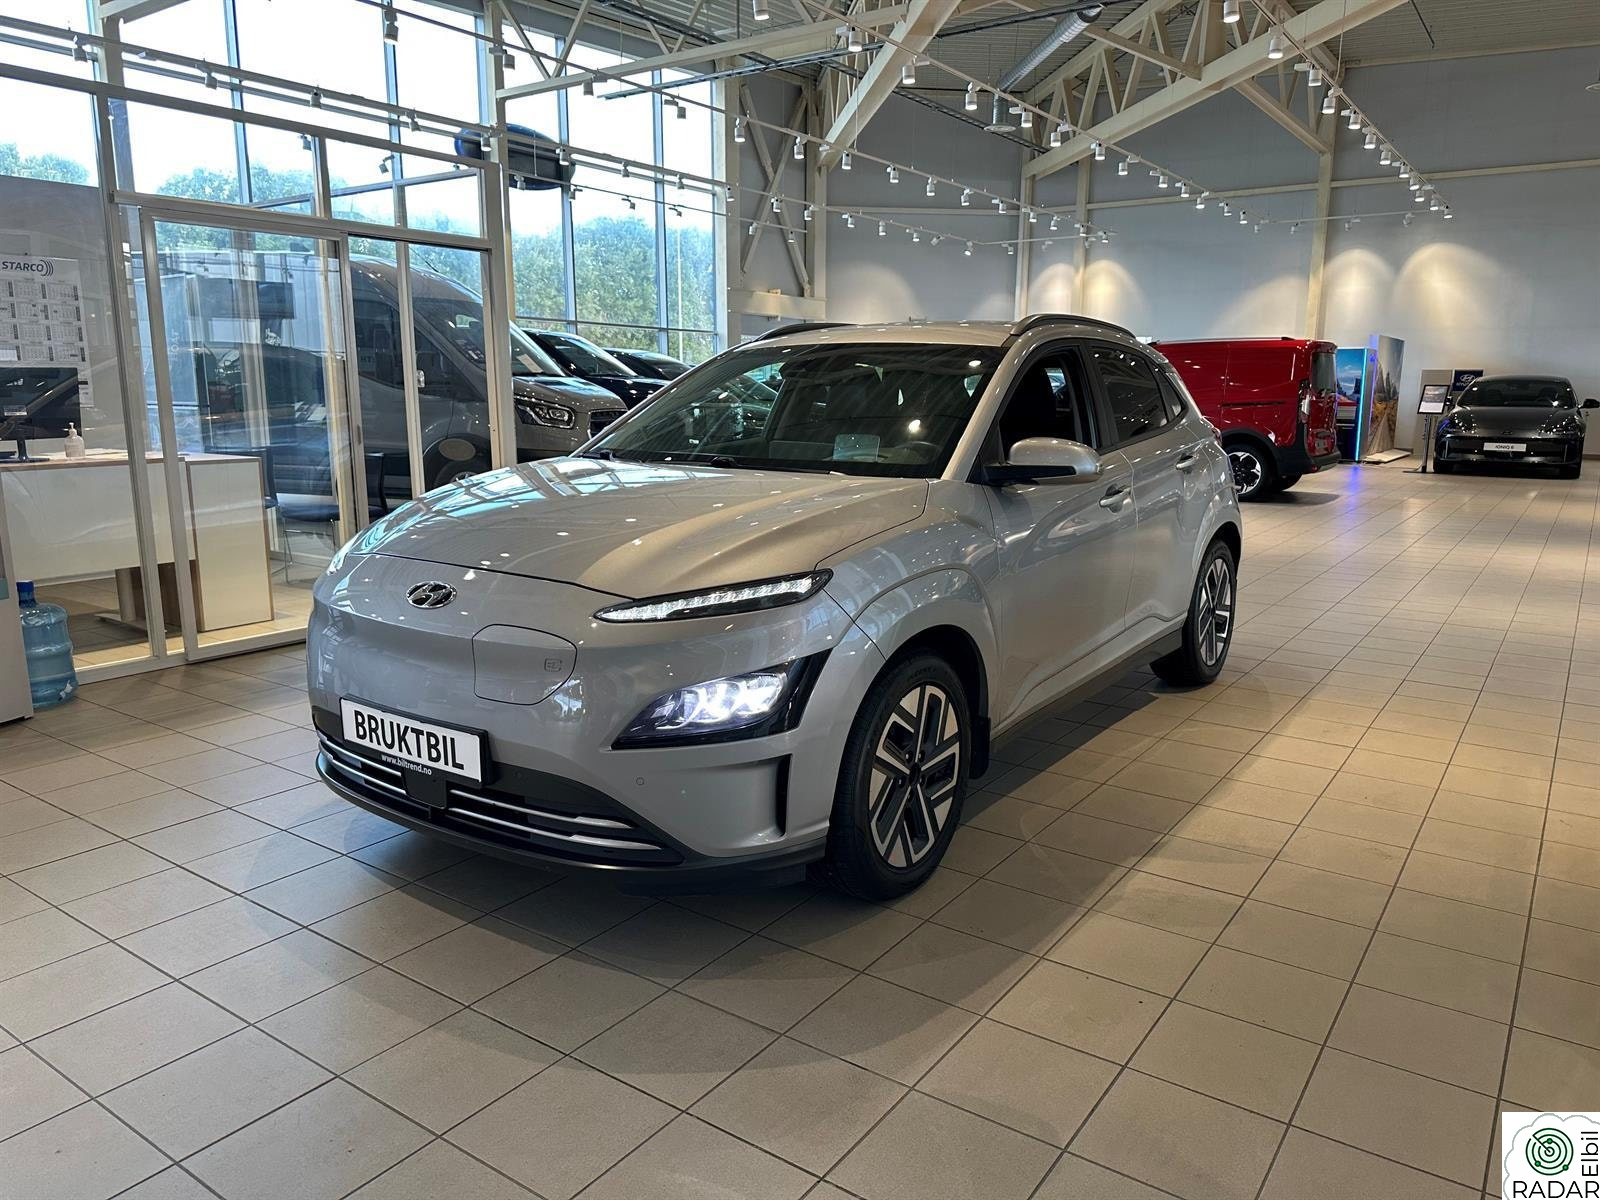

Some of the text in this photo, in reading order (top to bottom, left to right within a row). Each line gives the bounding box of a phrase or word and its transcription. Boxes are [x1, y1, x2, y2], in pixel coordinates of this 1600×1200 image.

[1, 260, 45, 273] STARCO
[353, 709, 465, 771] BRUKTBIL
[381, 754, 433, 776] www.biltrend.no
